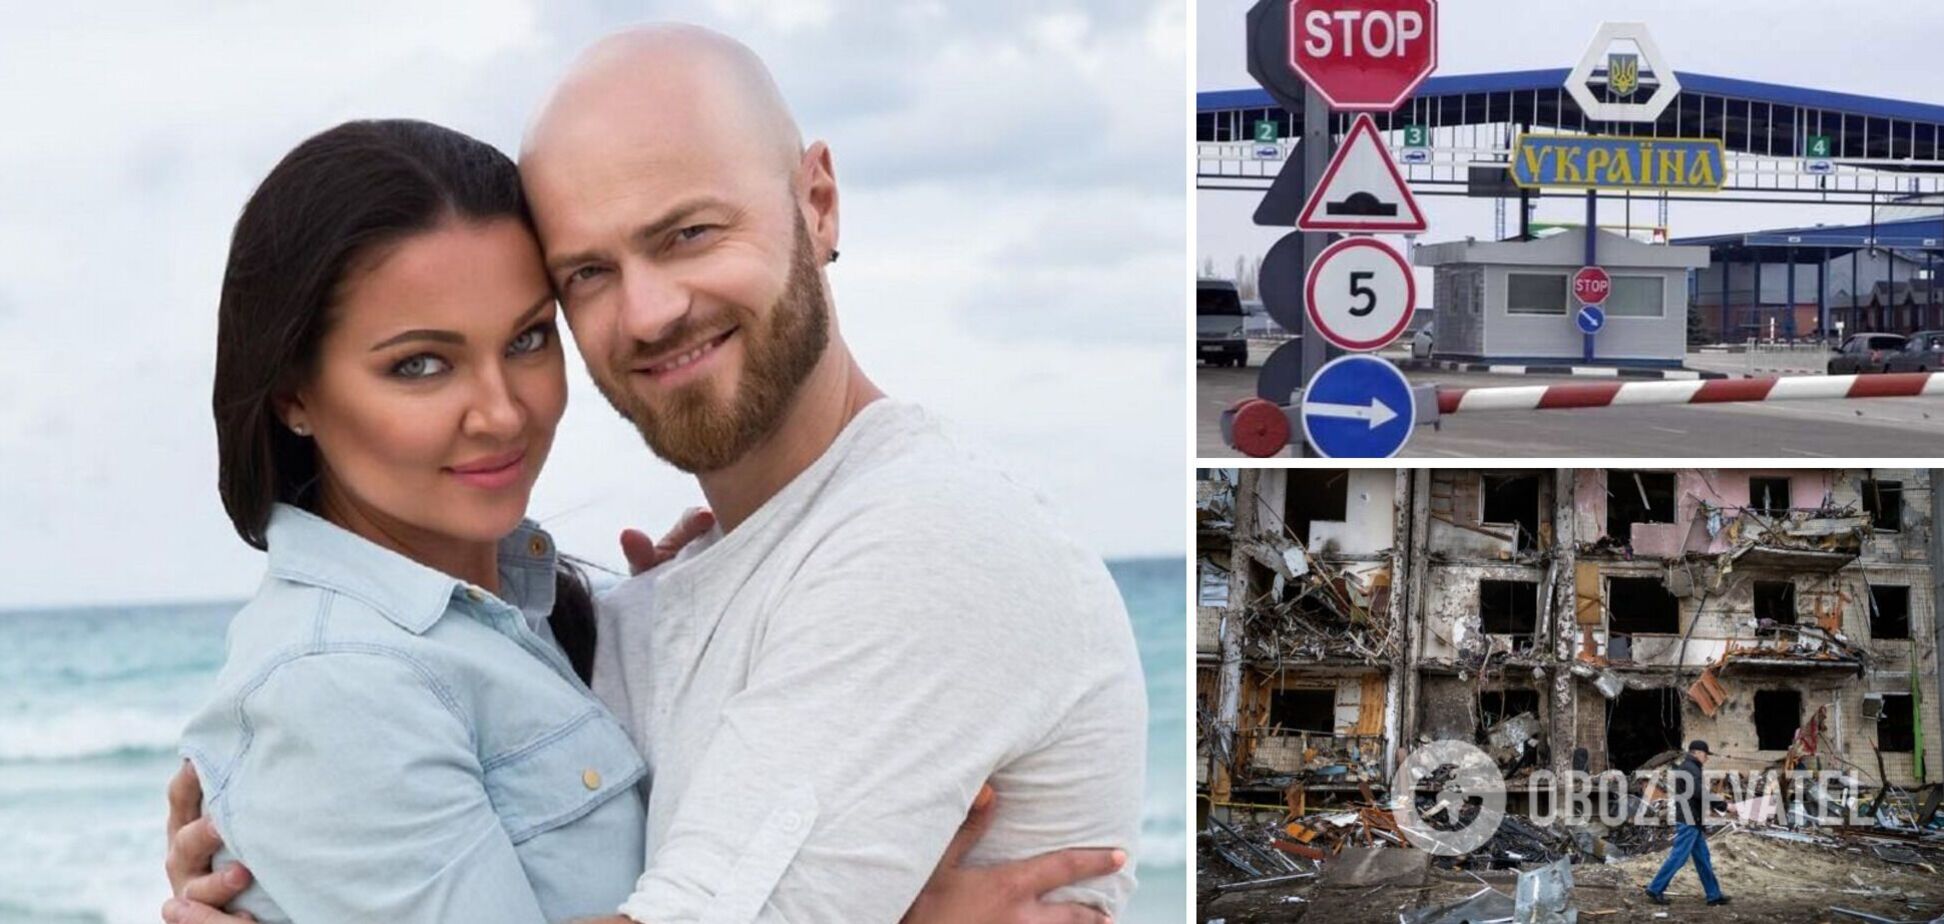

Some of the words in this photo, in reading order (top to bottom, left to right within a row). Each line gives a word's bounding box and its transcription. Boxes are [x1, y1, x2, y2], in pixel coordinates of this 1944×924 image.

[1304, 10, 1423, 58] STOP
[1259, 123, 1272, 140] 2
[1409, 129, 1421, 145] 3
[1812, 140, 1825, 155] 4
[1522, 141, 1715, 185] УКРАЇНА
[1348, 271, 1377, 317] 5
[1575, 278, 1609, 293] STOP
